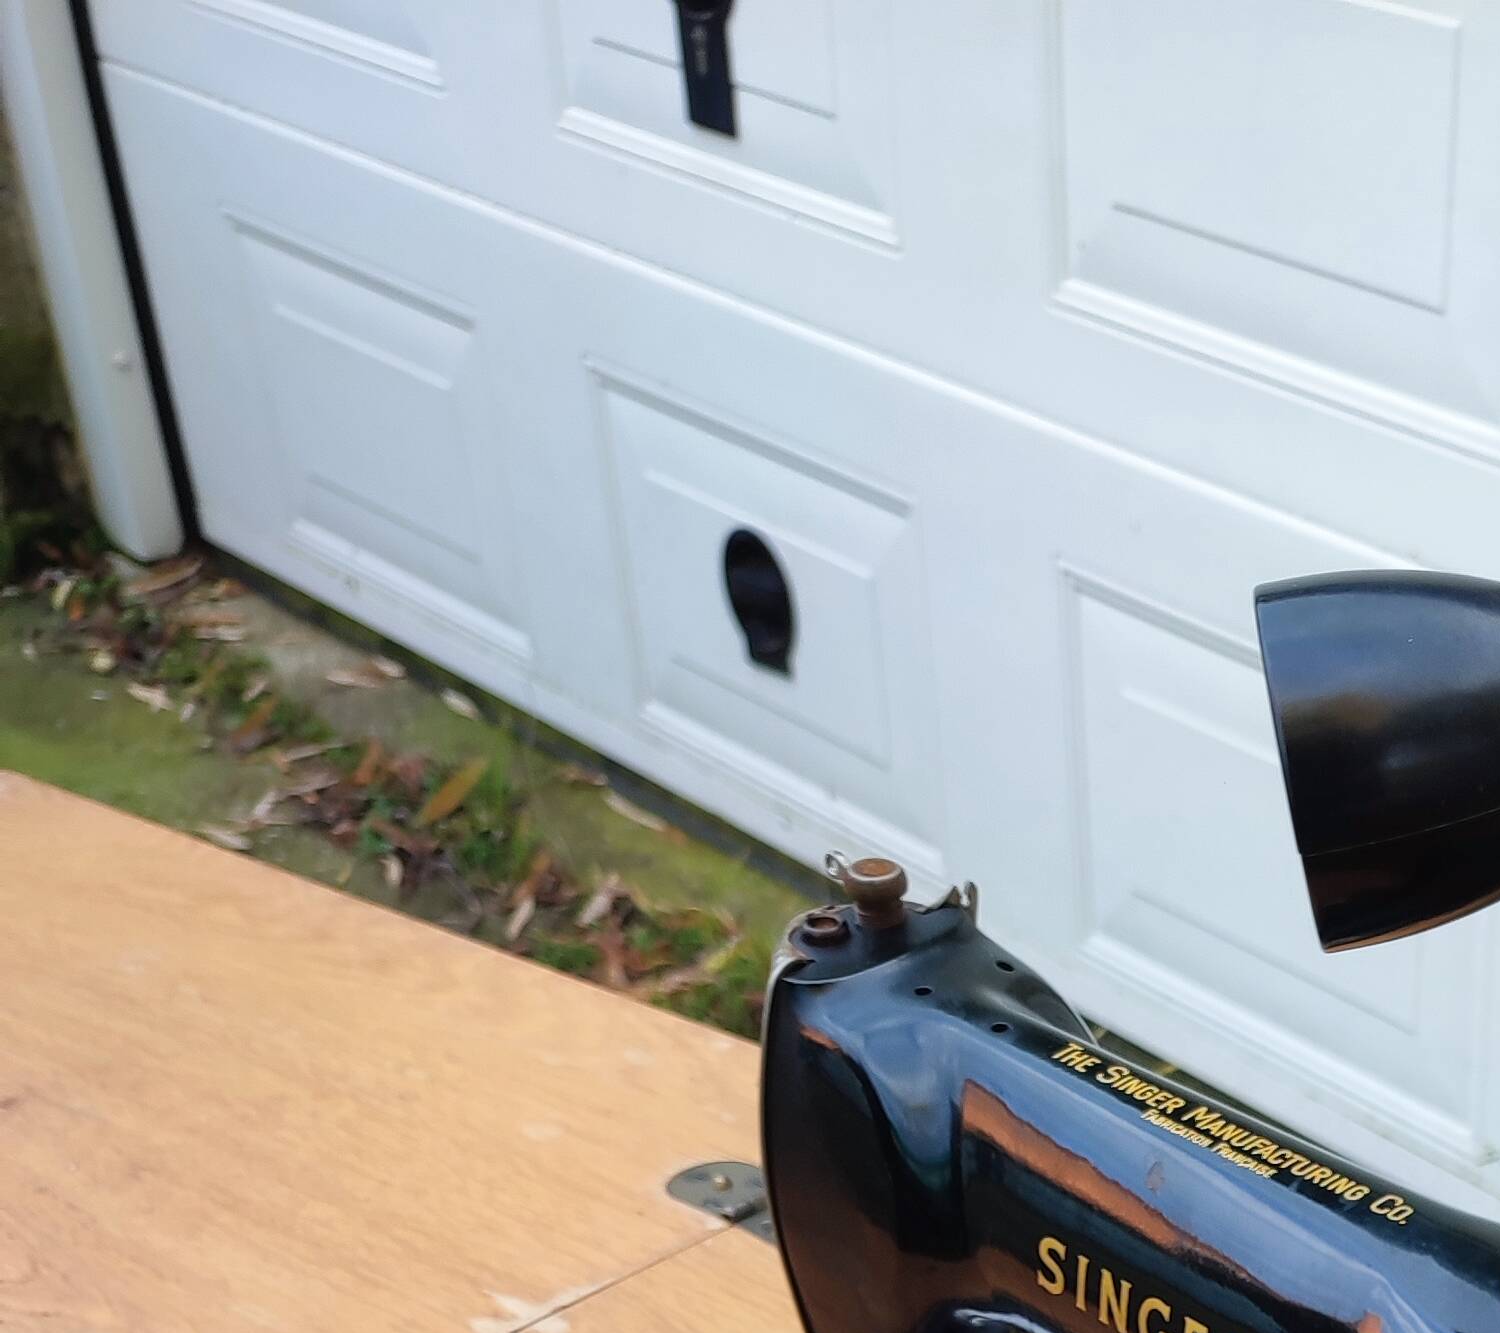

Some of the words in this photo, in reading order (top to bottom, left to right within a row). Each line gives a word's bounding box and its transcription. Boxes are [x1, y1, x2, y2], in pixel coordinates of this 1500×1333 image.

[1051, 1042, 1101, 1074] THE
[1096, 1065, 1186, 1114] SINGER
[1180, 1106, 1371, 1202] MANUFACTURING
[1370, 1194, 1417, 1225] CO.
